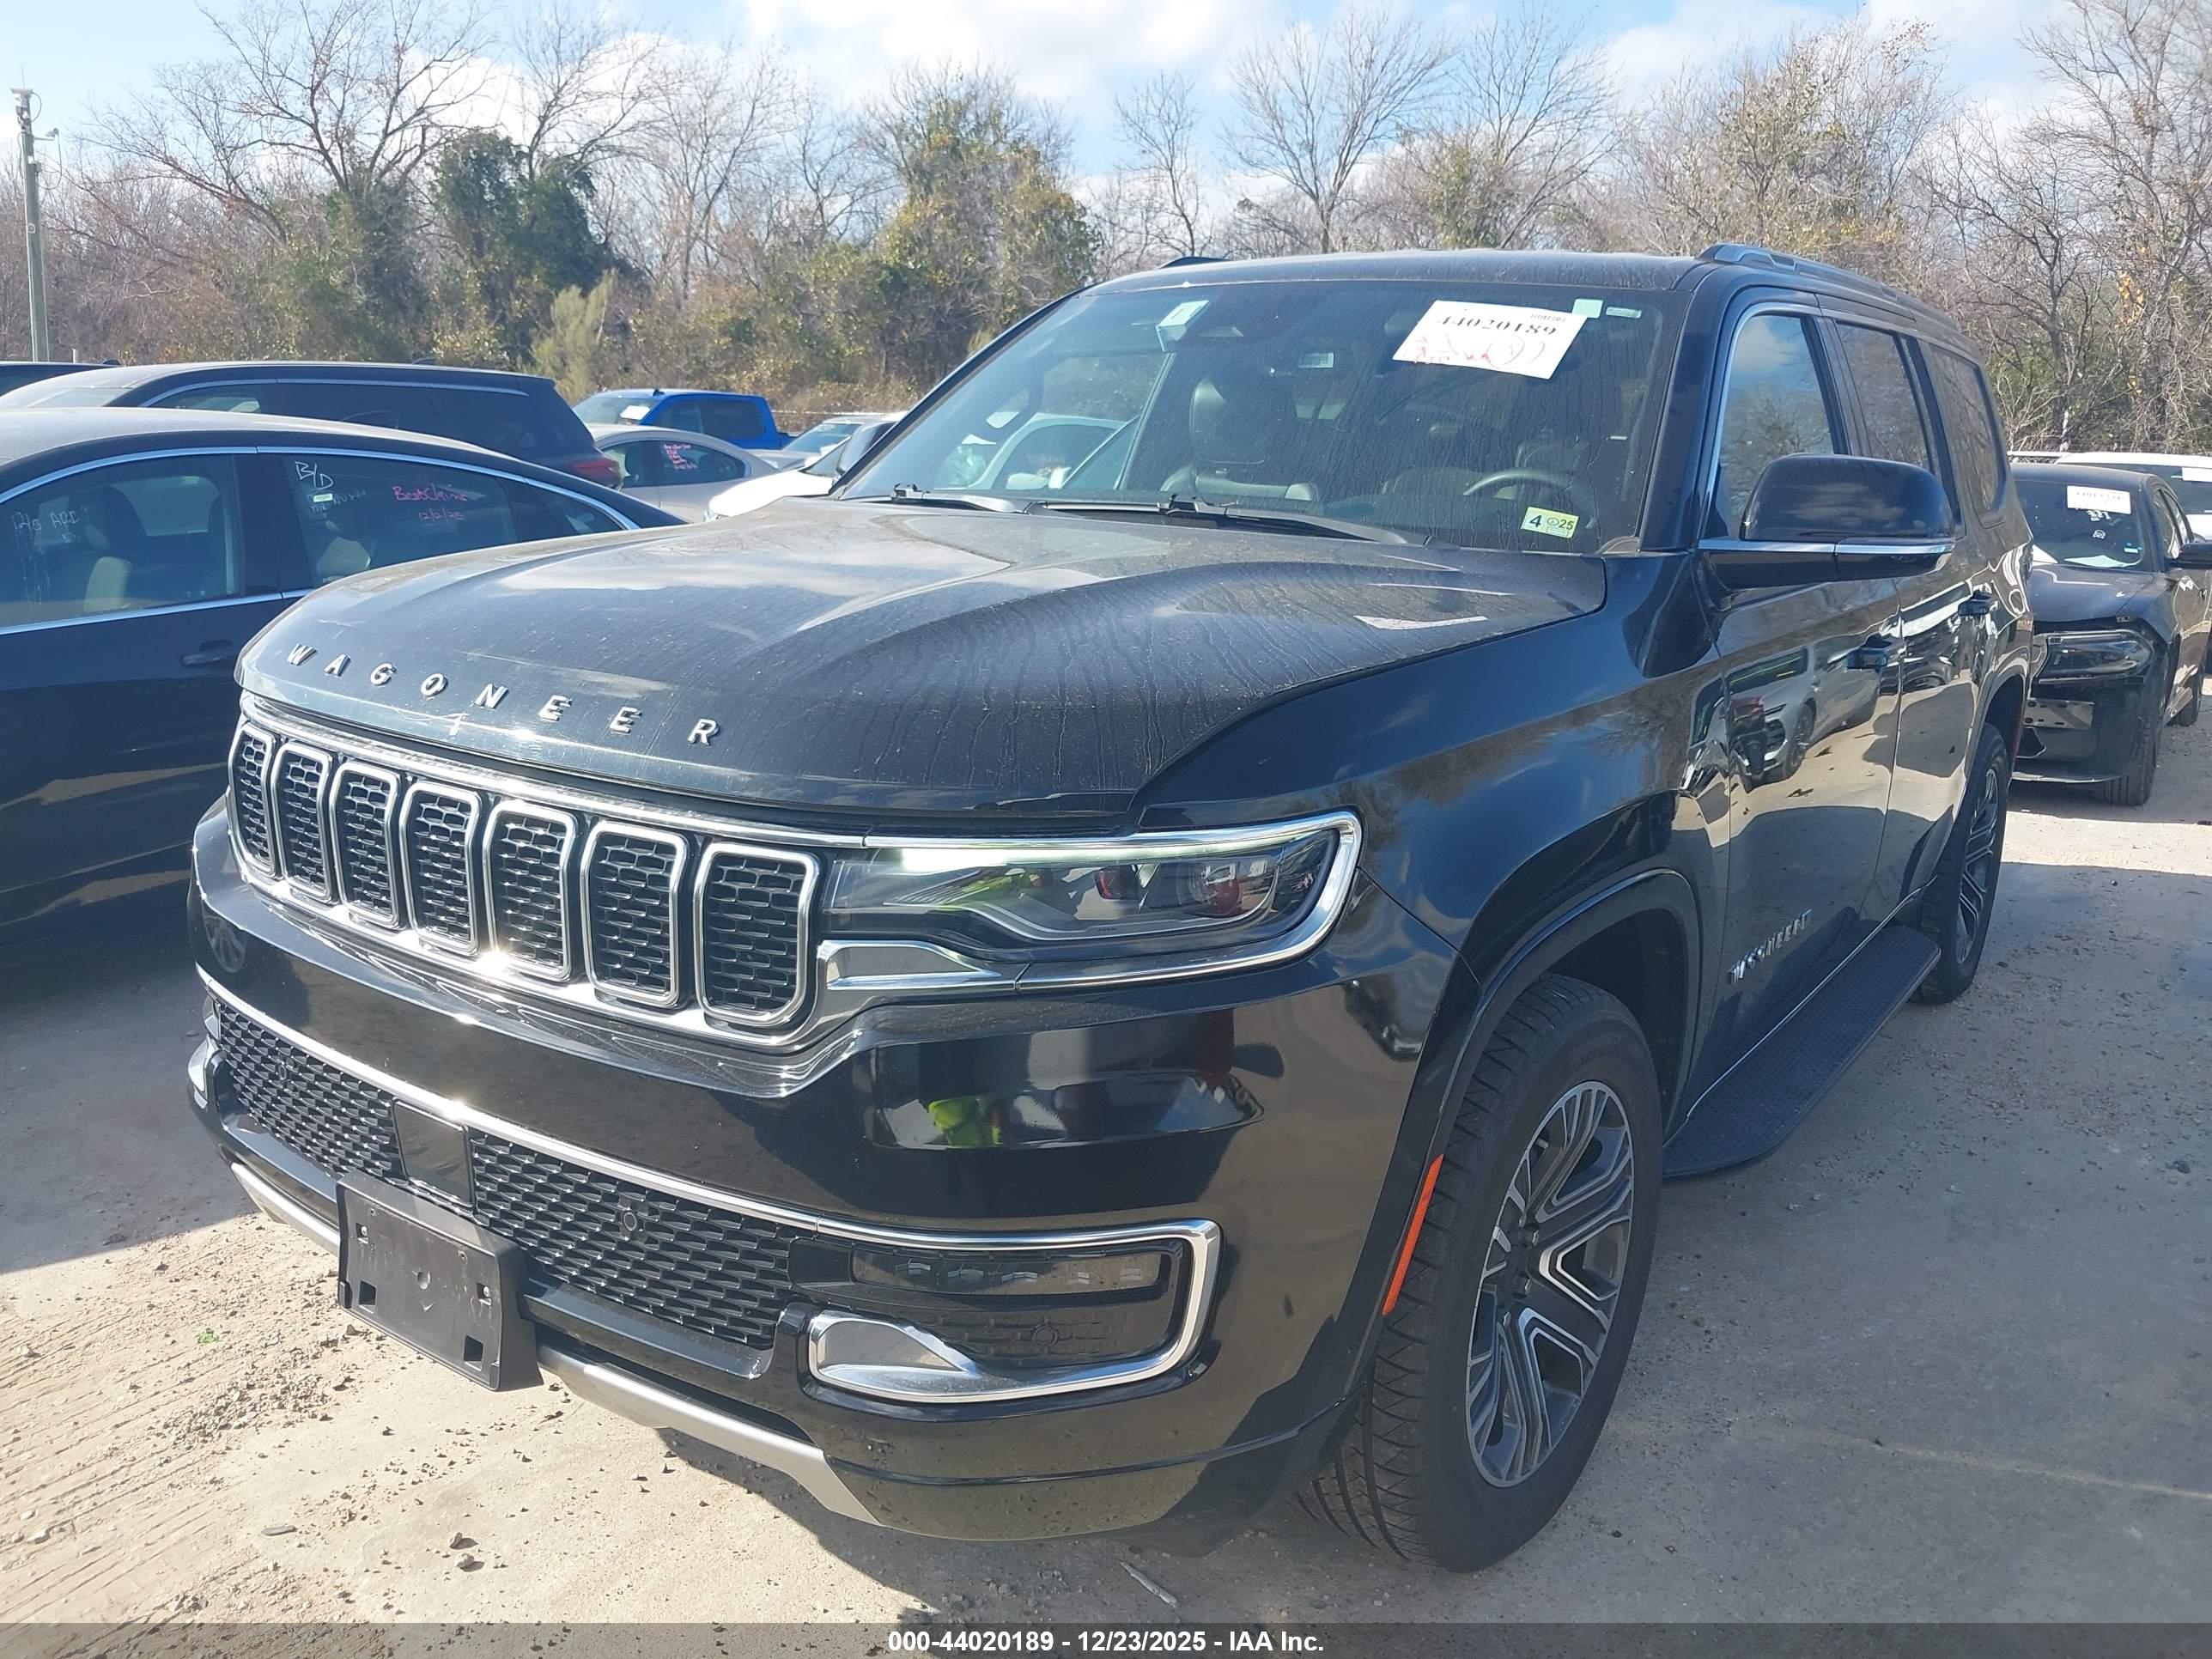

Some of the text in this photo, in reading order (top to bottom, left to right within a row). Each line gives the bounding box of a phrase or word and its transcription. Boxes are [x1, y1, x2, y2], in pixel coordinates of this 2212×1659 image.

[1437, 316, 1557, 336] 44020189
[1529, 515, 1574, 530] 4 25
[287, 643, 720, 745] WAGONEER
